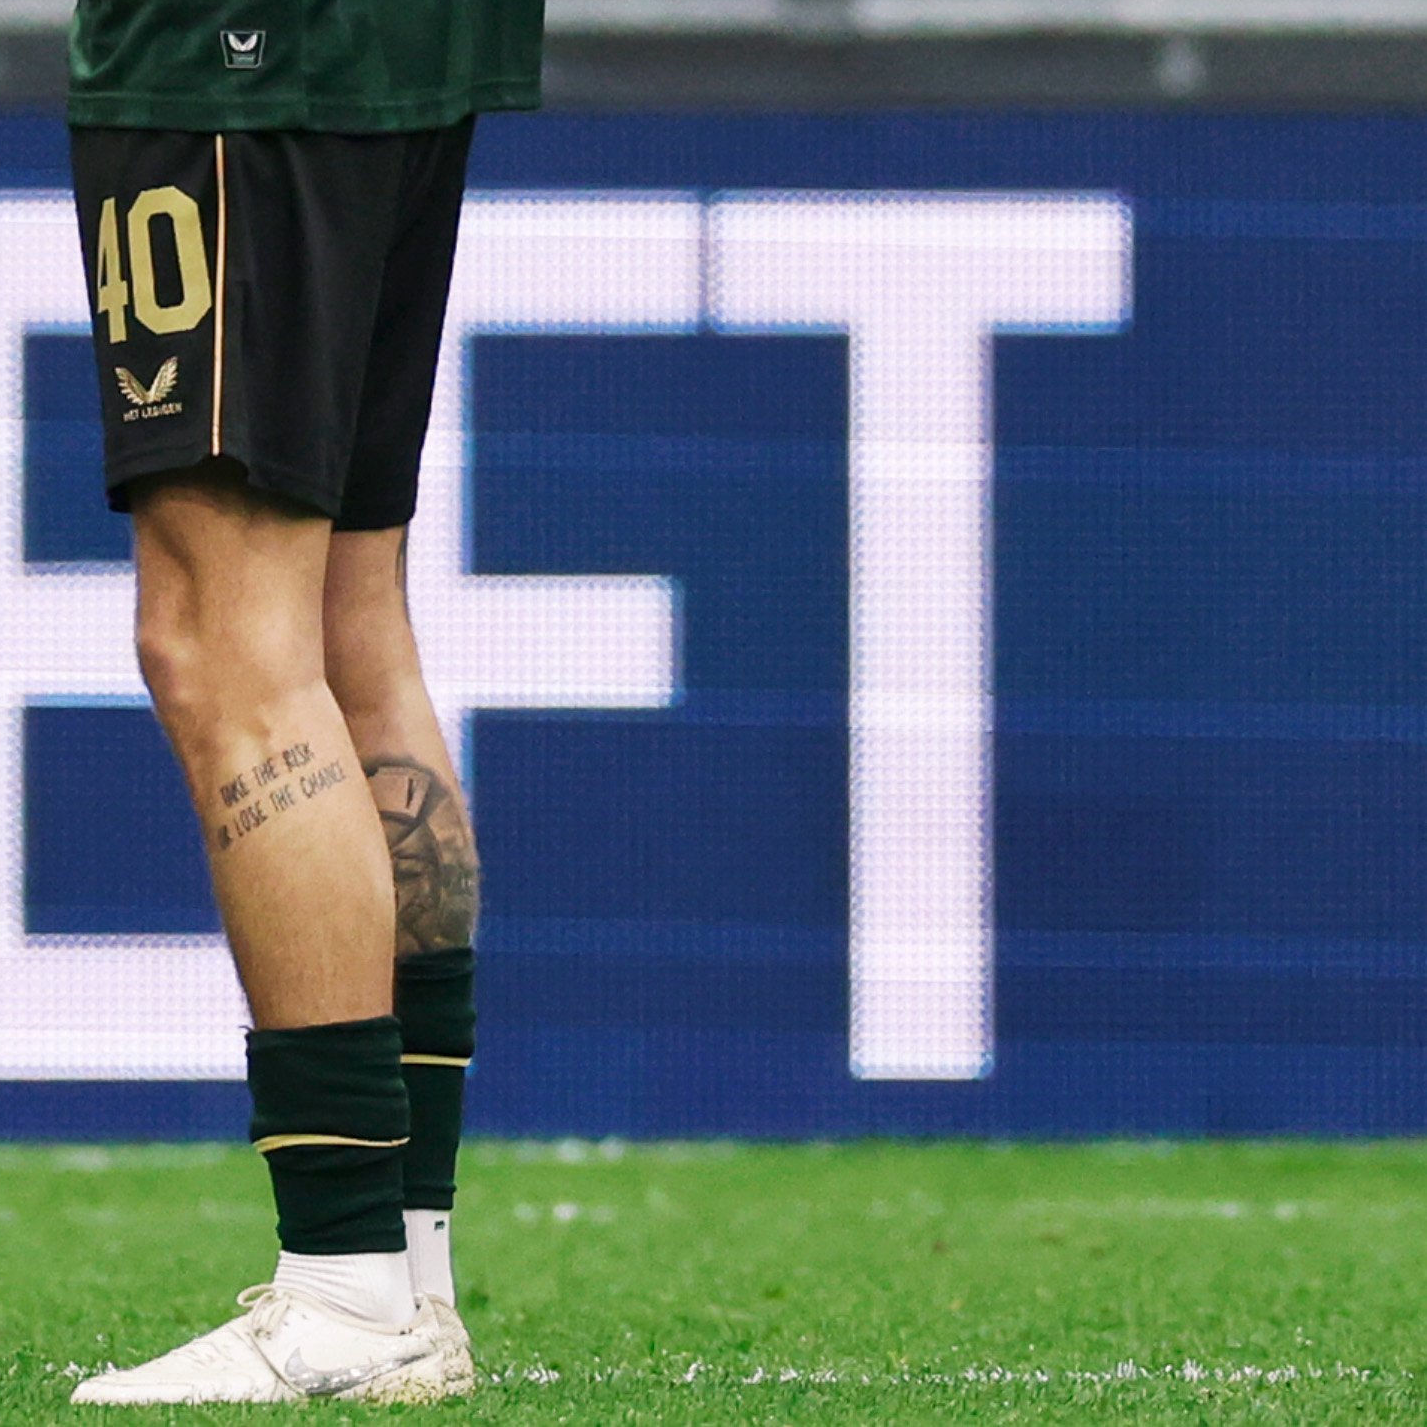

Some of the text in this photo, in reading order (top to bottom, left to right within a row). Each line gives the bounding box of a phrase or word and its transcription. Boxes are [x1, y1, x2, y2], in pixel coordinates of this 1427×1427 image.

[97, 185, 213, 344] 40
[252, 756, 280, 787] THE
[282, 741, 315, 773] RISK
[233, 799, 268, 837] LOSE
[269, 784, 296, 812] THE
